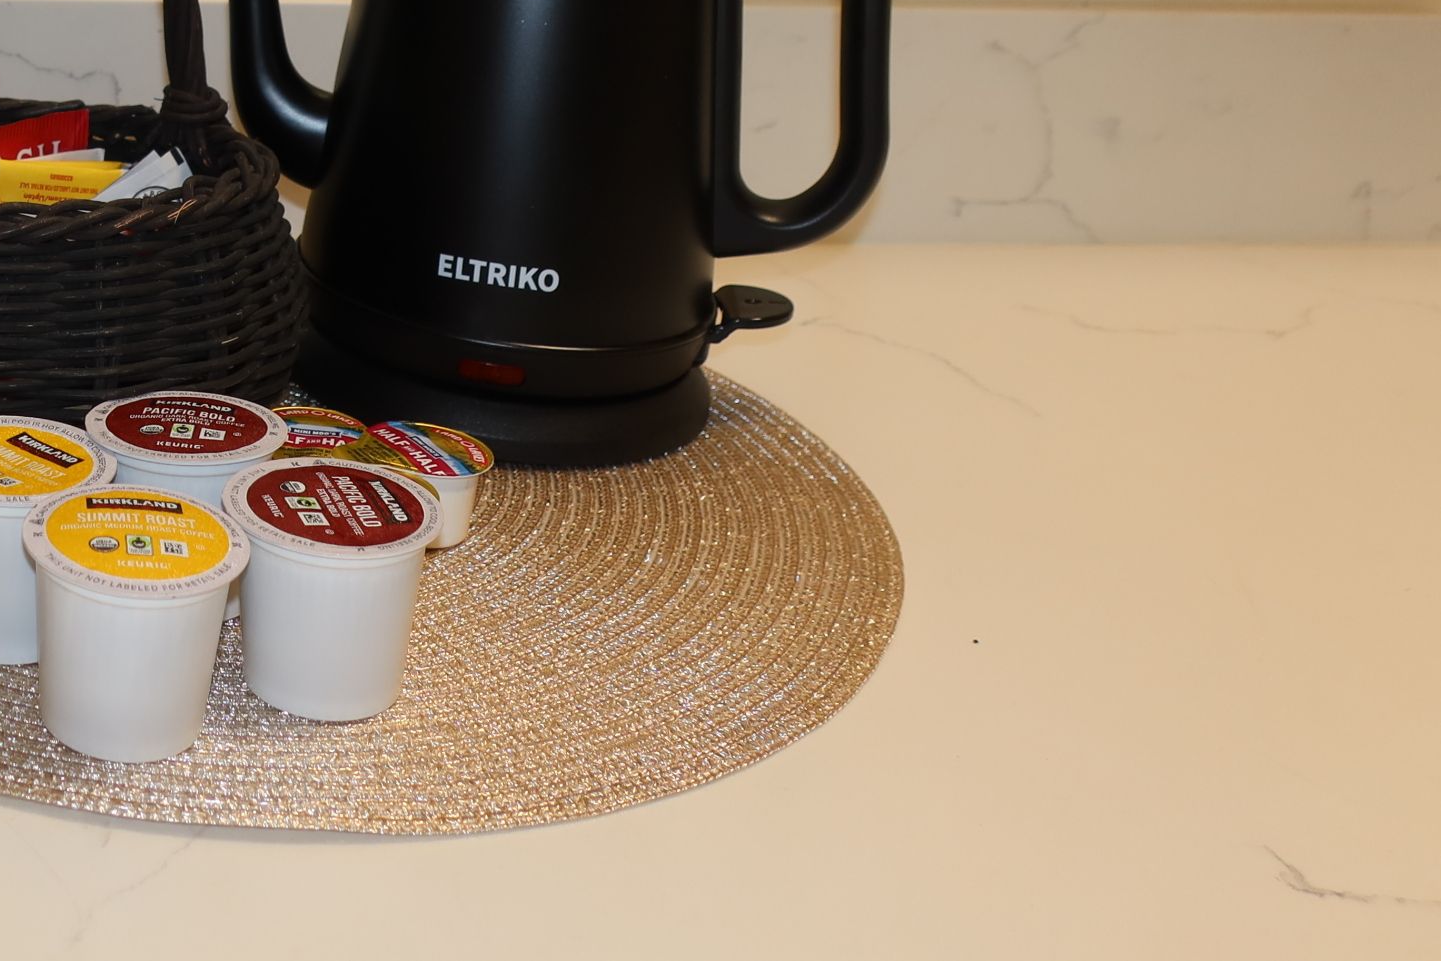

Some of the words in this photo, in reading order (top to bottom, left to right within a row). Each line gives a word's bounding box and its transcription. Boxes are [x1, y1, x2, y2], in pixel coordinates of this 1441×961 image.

[437, 253, 560, 293] ELTRIKO
[142, 406, 196, 417] PACIFIC
[199, 411, 236, 423] BOLD
[156, 399, 232, 413] KIRKLAND
[16, 434, 79, 464] KIRKLAND
[156, 440, 202, 450] KEURIG
[286, 435, 306, 445] LF
[322, 437, 346, 447] HA
[372, 428, 411, 449] HALF
[409, 451, 448, 476] HALF
[26, 461, 67, 479] ROAST
[92, 498, 178, 509] KIRKLAND
[332, 476, 367, 503] PACIFIC
[352, 504, 382, 527] BOLD
[368, 481, 408, 522] KIRKLAND
[60, 523, 102, 531] ORGANIC
[104, 523, 144, 531] MEDIUM
[76, 512, 140, 523] SUMMIT
[146, 515, 196, 529] ROAST
[117, 559, 170, 570] KEURIG
[86, 574, 106, 585] NOT
[110, 579, 159, 591] LABELED
[161, 581, 183, 591] FOR
